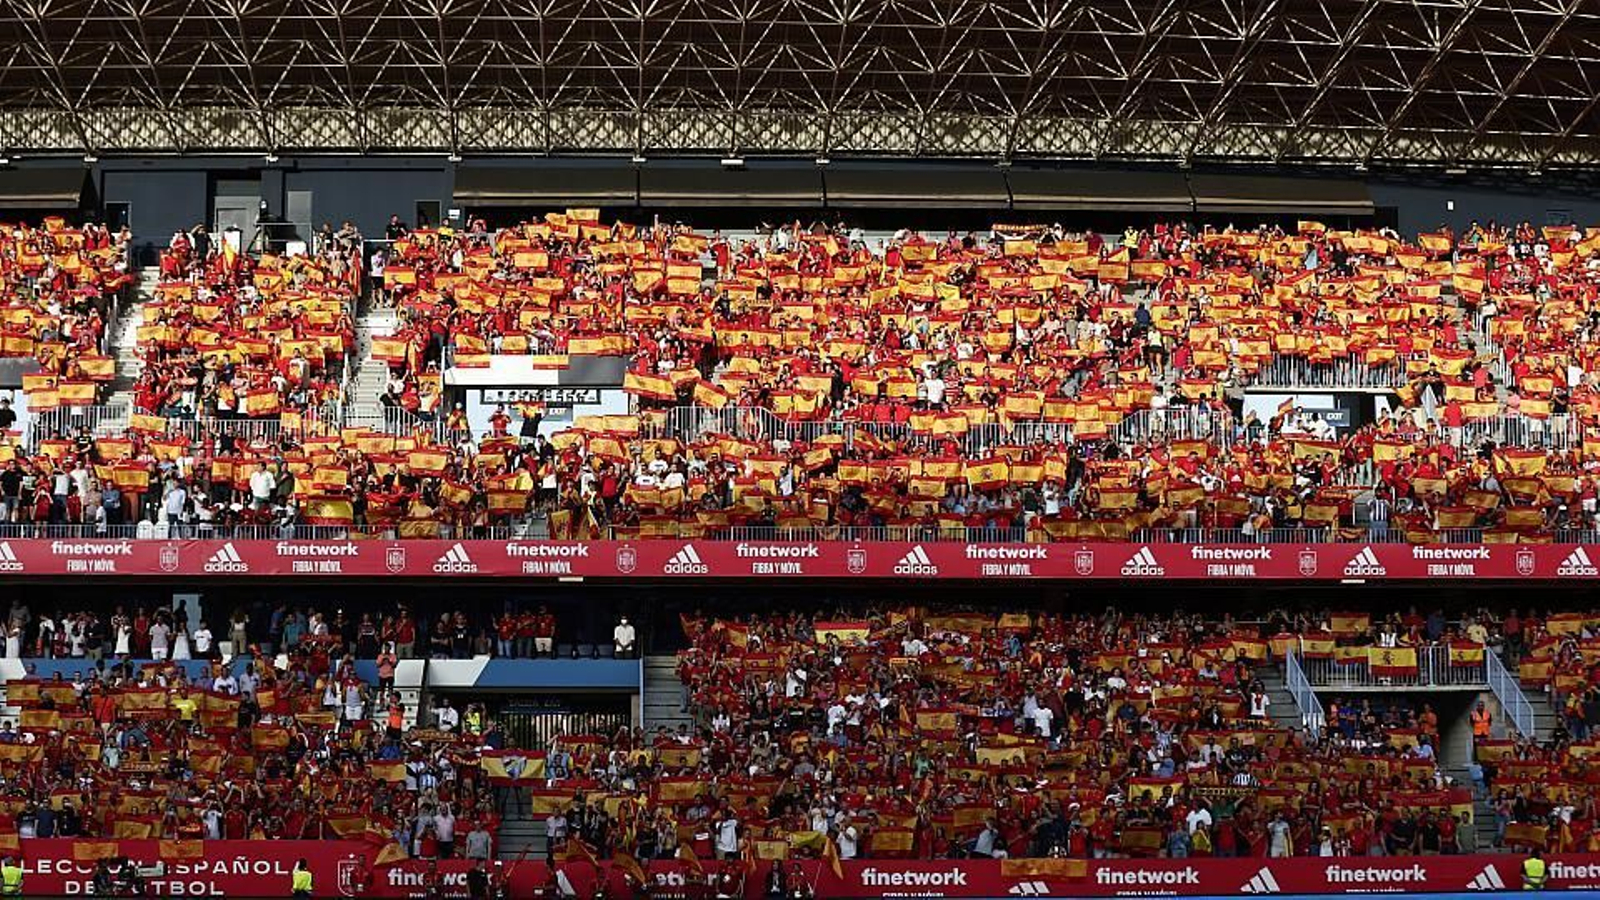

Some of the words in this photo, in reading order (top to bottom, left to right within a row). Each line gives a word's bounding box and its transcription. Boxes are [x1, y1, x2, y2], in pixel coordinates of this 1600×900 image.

[51, 541, 132, 555] finetwork
[276, 542, 358, 556] finetwork
[506, 543, 588, 557] finetwork
[736, 543, 818, 557] finetwork
[966, 544, 1047, 559] finetwork
[1191, 546, 1271, 560] finetwork
[1412, 545, 1490, 560] finetwork
[204, 560, 249, 573] adidas
[433, 561, 478, 573] adidas
[664, 562, 709, 574] adidas
[894, 563, 938, 575] adidas
[1121, 563, 1165, 576] adidas
[1344, 563, 1387, 576] adidas
[1557, 563, 1599, 576] adidas
[157, 856, 301, 874] SPAÑOL
[1548, 861, 1600, 878] finet
[861, 867, 967, 886] finetwork
[1096, 866, 1200, 884] finetwork
[1325, 864, 1426, 882] finetwork
